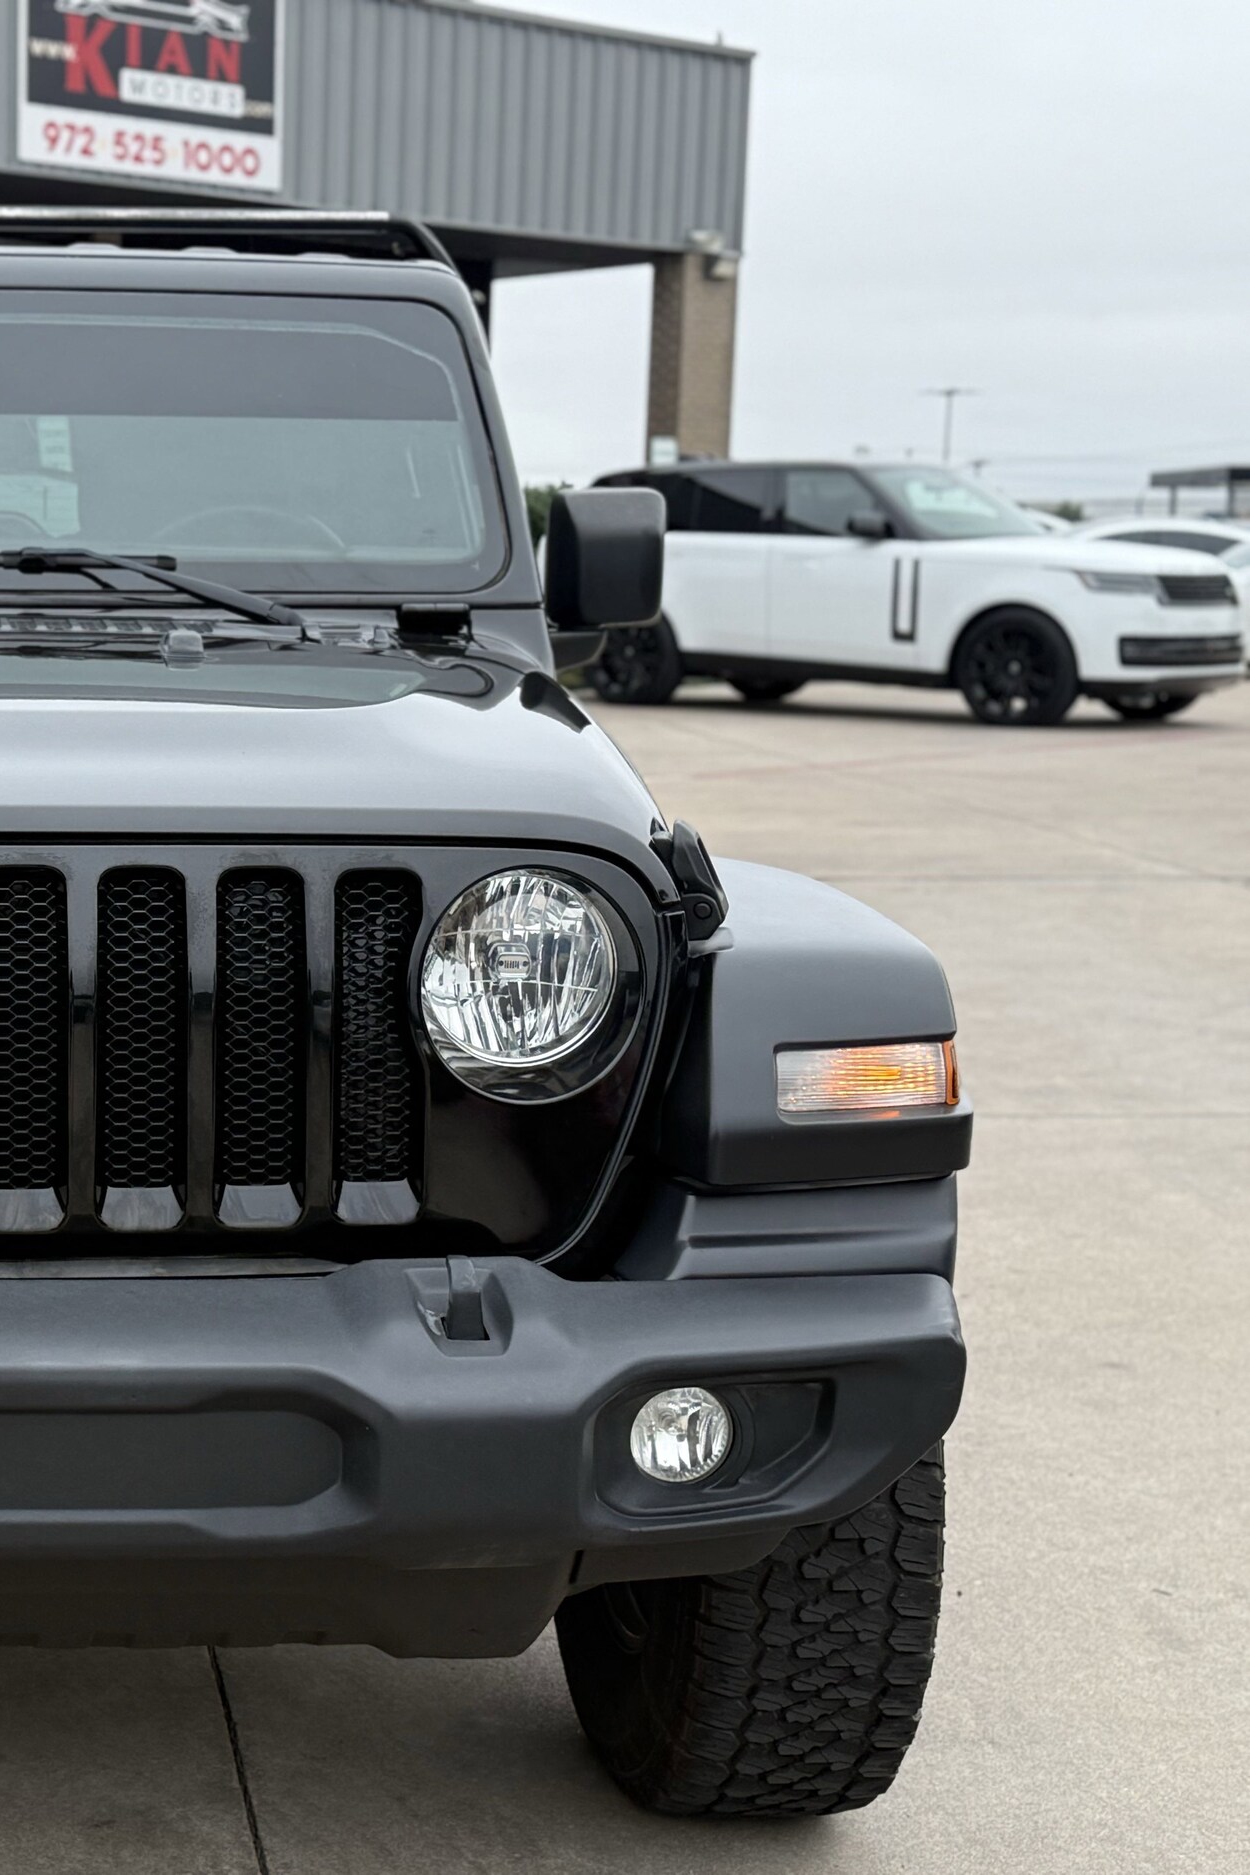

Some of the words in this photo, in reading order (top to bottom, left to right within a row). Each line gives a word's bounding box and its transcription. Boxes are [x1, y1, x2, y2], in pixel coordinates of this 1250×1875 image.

[64, 13, 242, 99] KIAN
[43, 121, 96, 157] 972
[112, 131, 165, 166] 525
[182, 140, 261, 177] 1000
